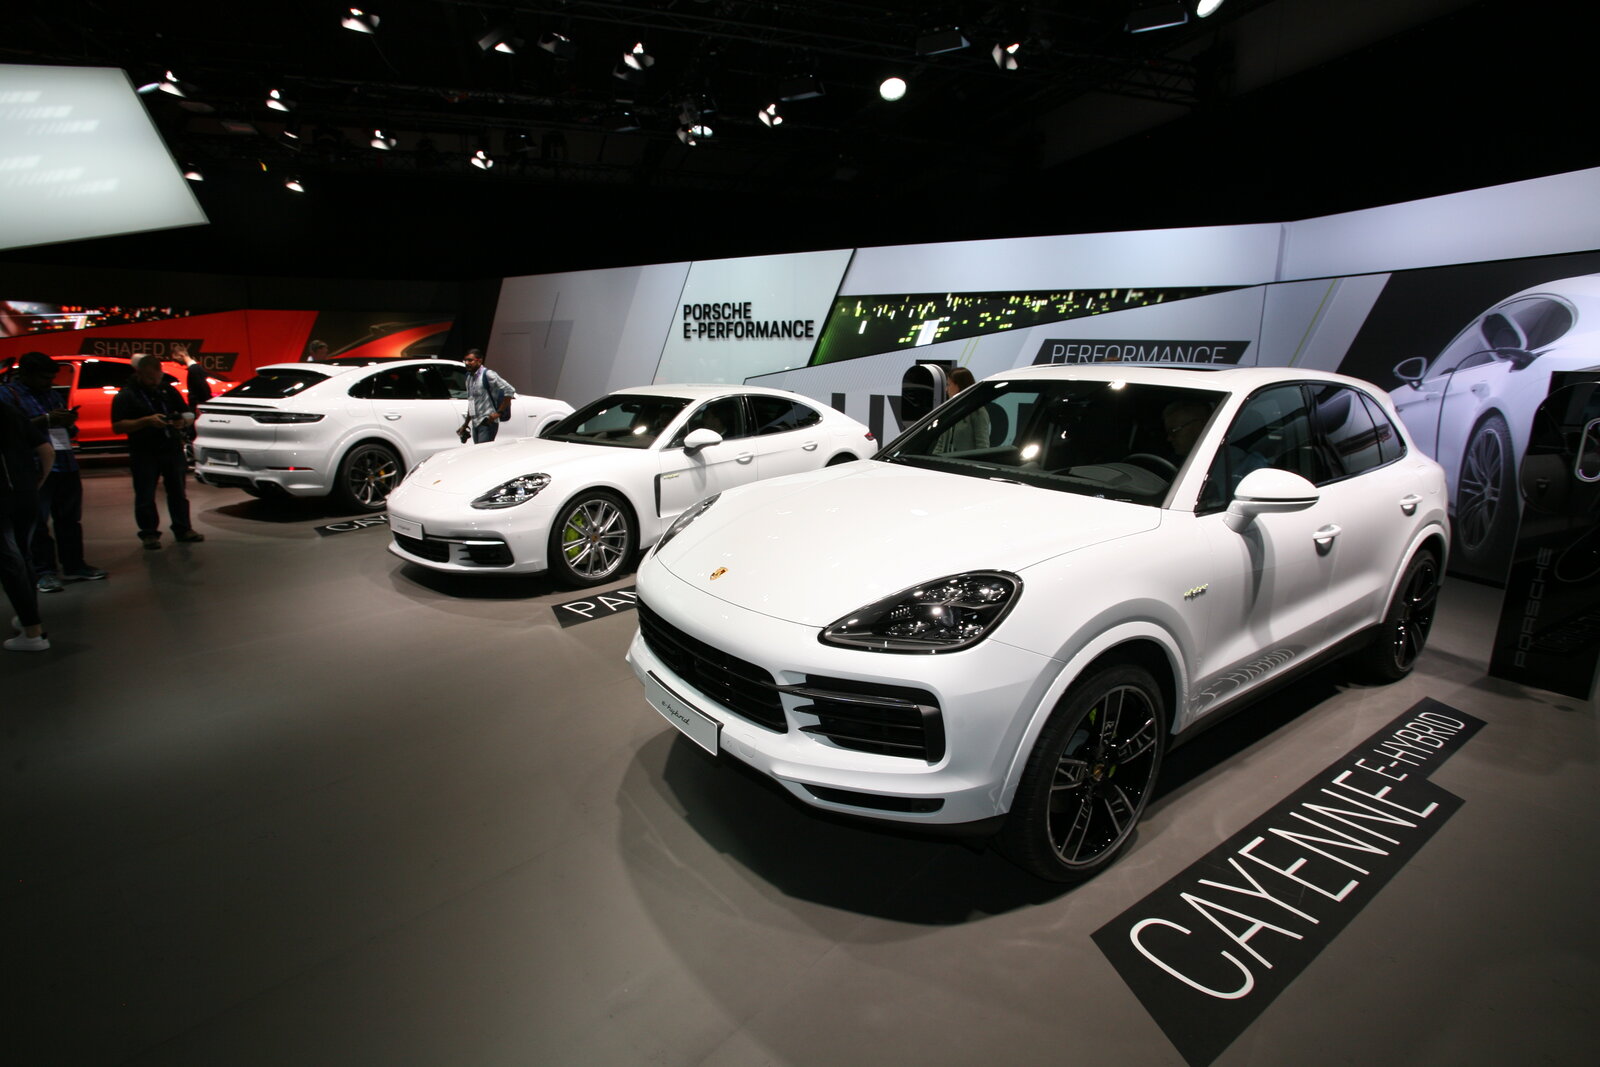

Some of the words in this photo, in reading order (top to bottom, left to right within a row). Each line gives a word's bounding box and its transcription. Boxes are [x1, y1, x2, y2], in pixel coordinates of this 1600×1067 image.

[683, 302, 752, 320] PORSCHE
[683, 320, 815, 339] E-PERFORMANCE
[94, 341, 165, 357] SHAPED
[1051, 344, 1227, 364] PERFORMANCE
[1514, 547, 1553, 669] PORSCHE
[1129, 770, 1440, 1001] CAYENNE
[1356, 711, 1467, 783] E-HYBRID
